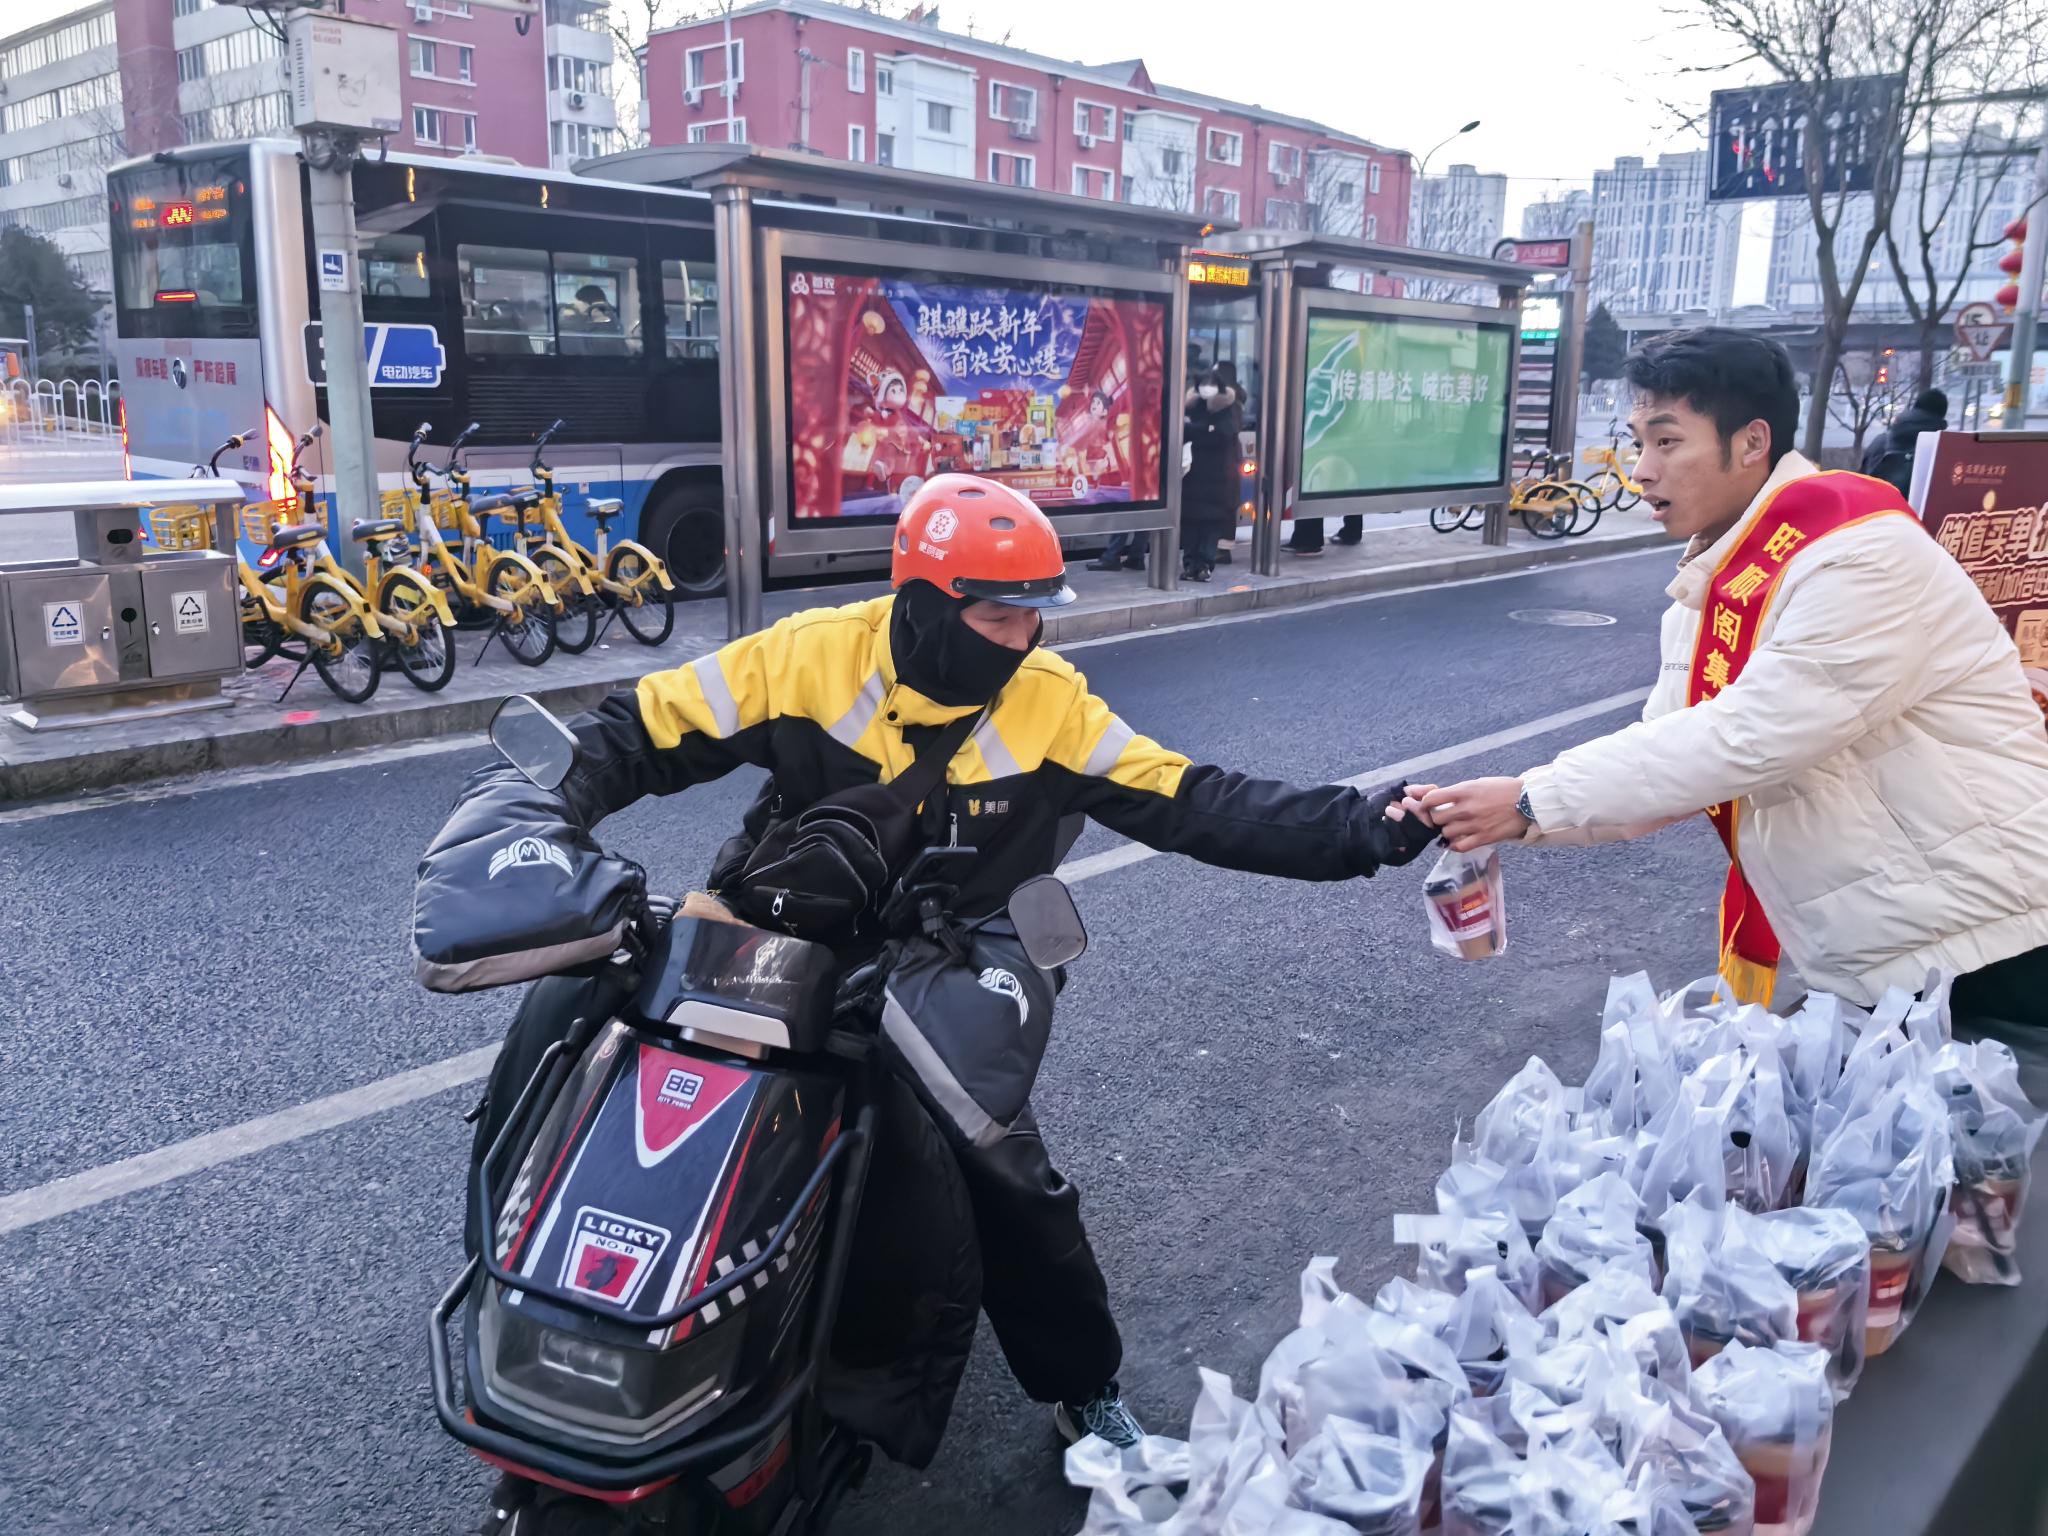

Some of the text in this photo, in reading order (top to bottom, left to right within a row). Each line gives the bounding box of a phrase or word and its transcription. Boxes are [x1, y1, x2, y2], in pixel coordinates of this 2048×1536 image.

[381, 365, 433, 380] 电动汽车
[944, 339, 1062, 379] 首农安心选
[1420, 371, 1489, 404] 城市美好
[1701, 522, 1807, 701] 旺顺阁集
[985, 801, 1009, 814] 美团
[666, 1074, 699, 1096] 88
[584, 1216, 660, 1246] LICKY
